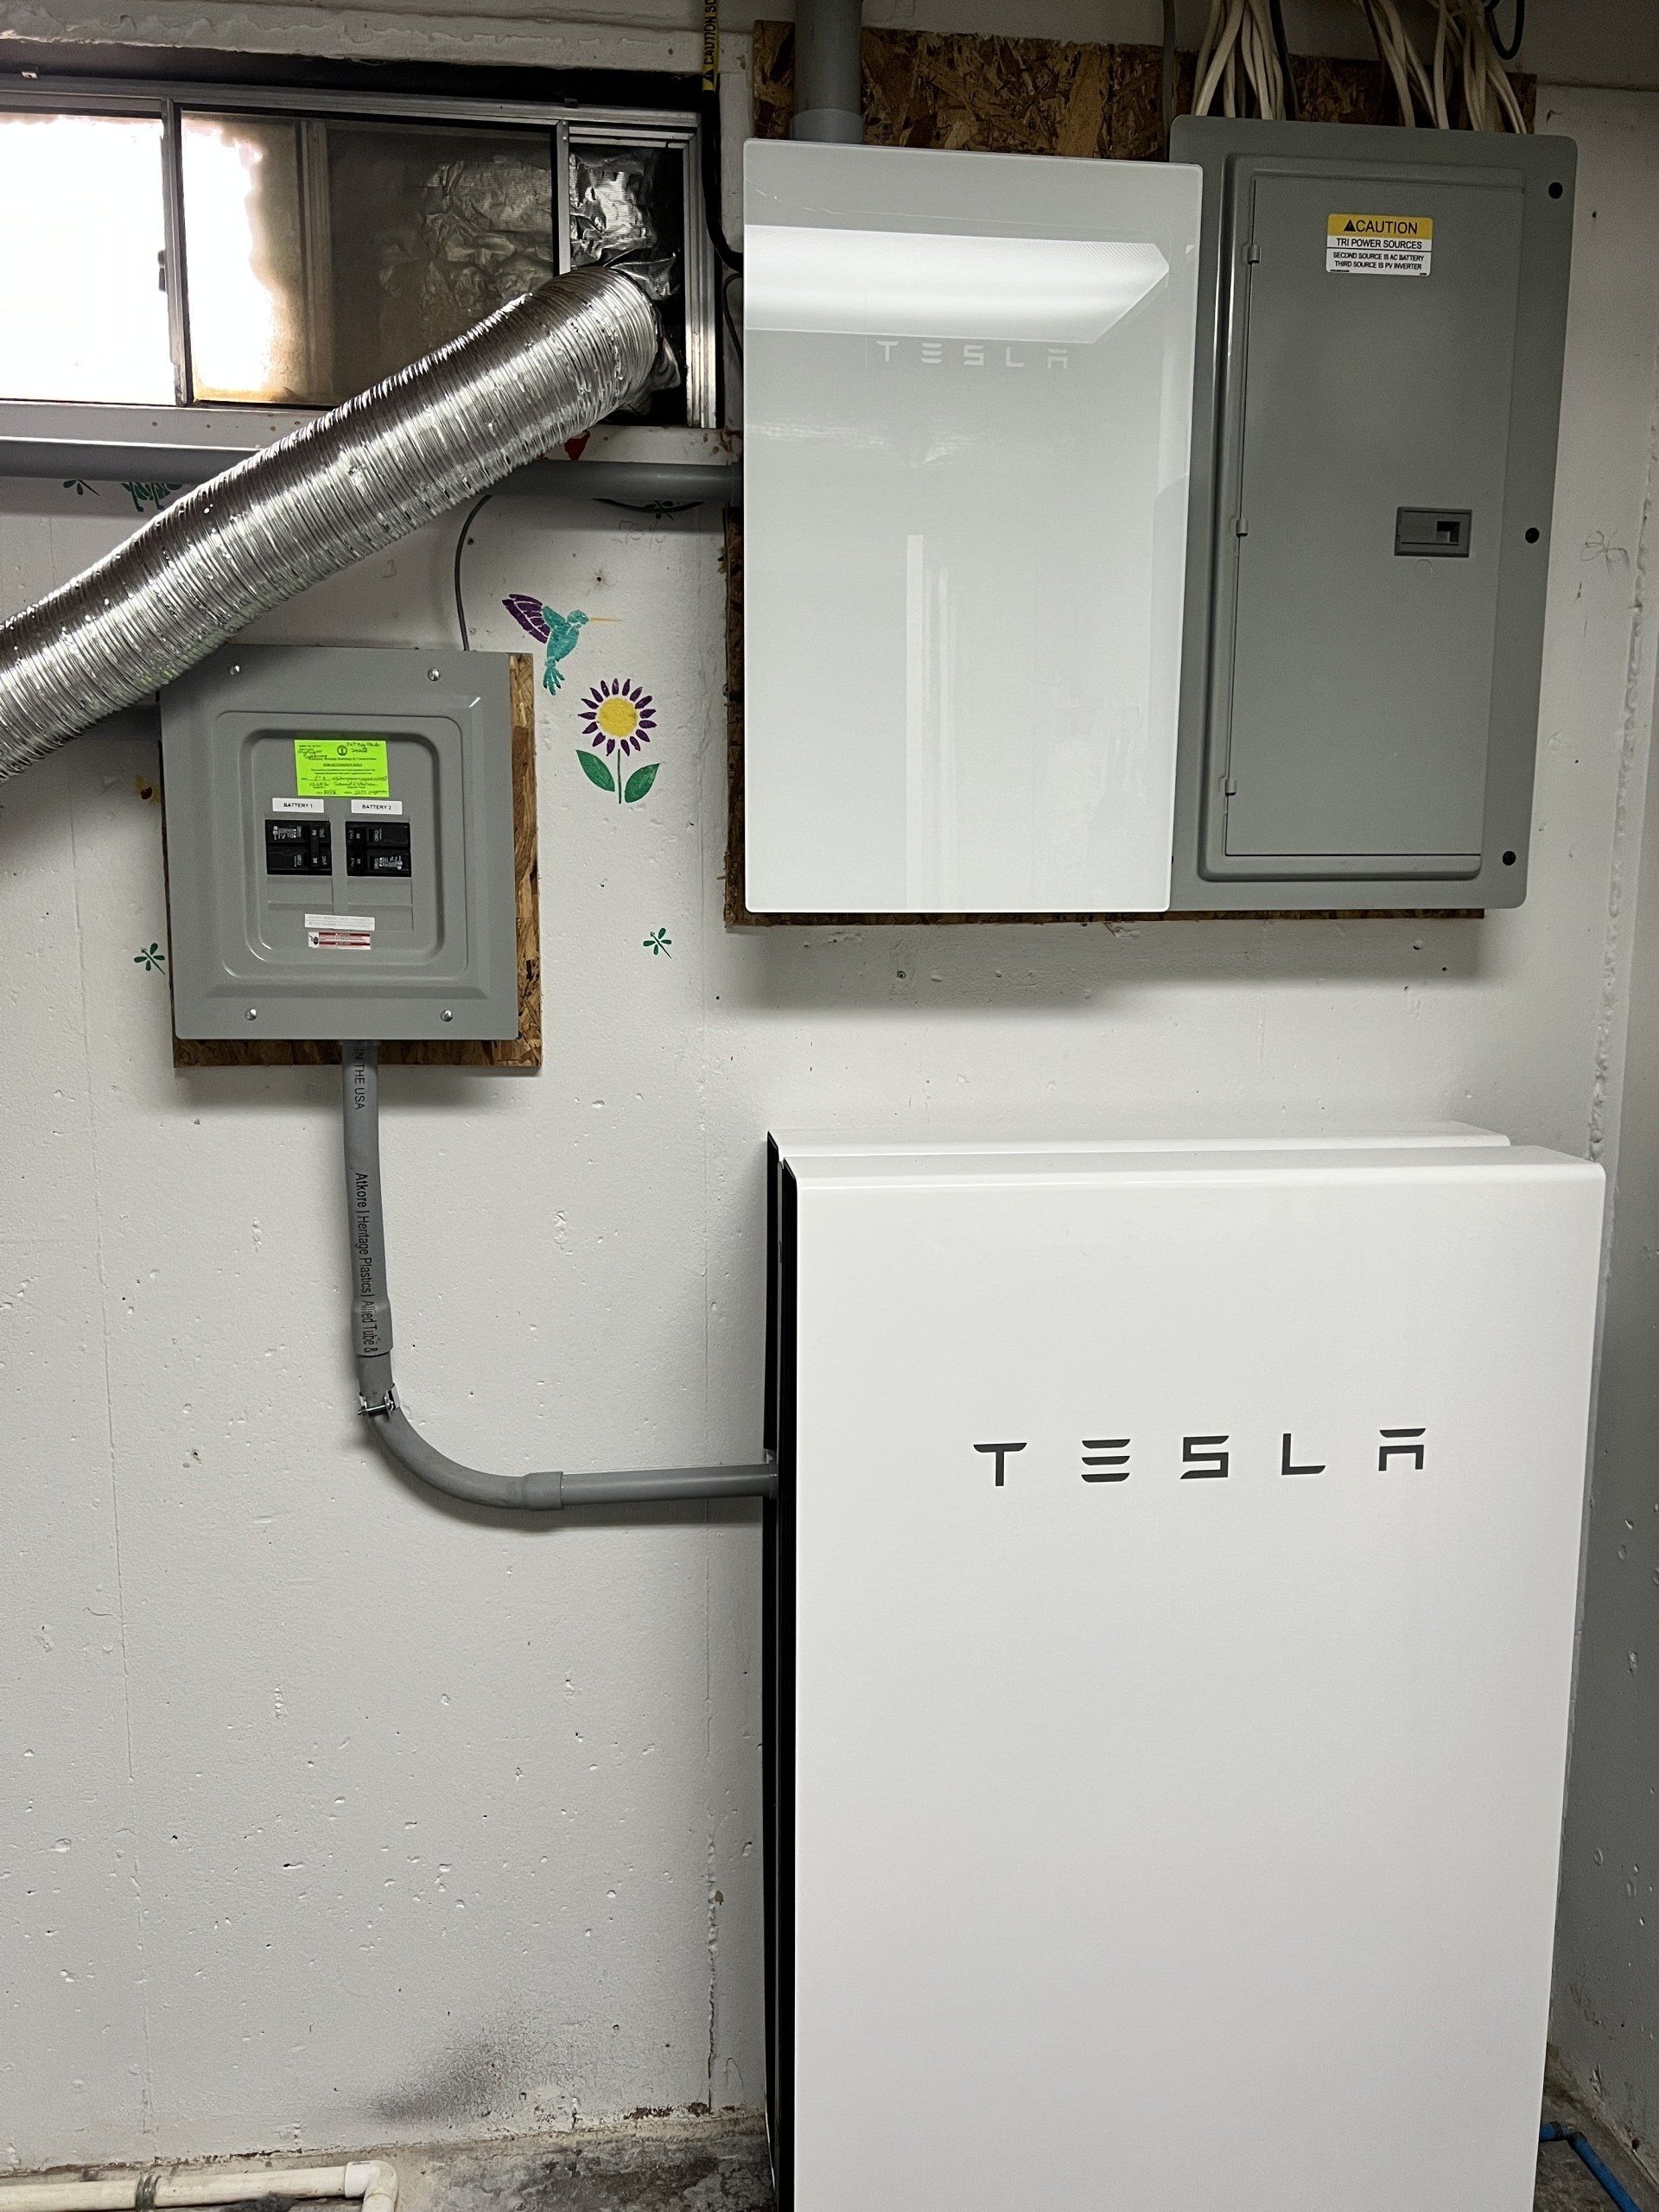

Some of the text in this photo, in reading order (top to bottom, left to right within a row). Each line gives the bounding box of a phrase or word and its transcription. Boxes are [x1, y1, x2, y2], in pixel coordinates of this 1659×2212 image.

[704, 16, 716, 65] CAUTION
[1336, 238, 1422, 249] TRI POWER SOURCES
[1356, 219, 1418, 234] CAUTION
[876, 340, 1069, 369] TESLA
[354, 1048, 365, 1109] IN THE USA
[355, 1173, 369, 1208] Atkore
[355, 1216, 371, 1255] Heritage
[359, 1257, 373, 1294] Plastics
[361, 1300, 378, 1323] Allied
[363, 1324, 378, 1345] Tube
[973, 1427, 1427, 1487] TESLA
